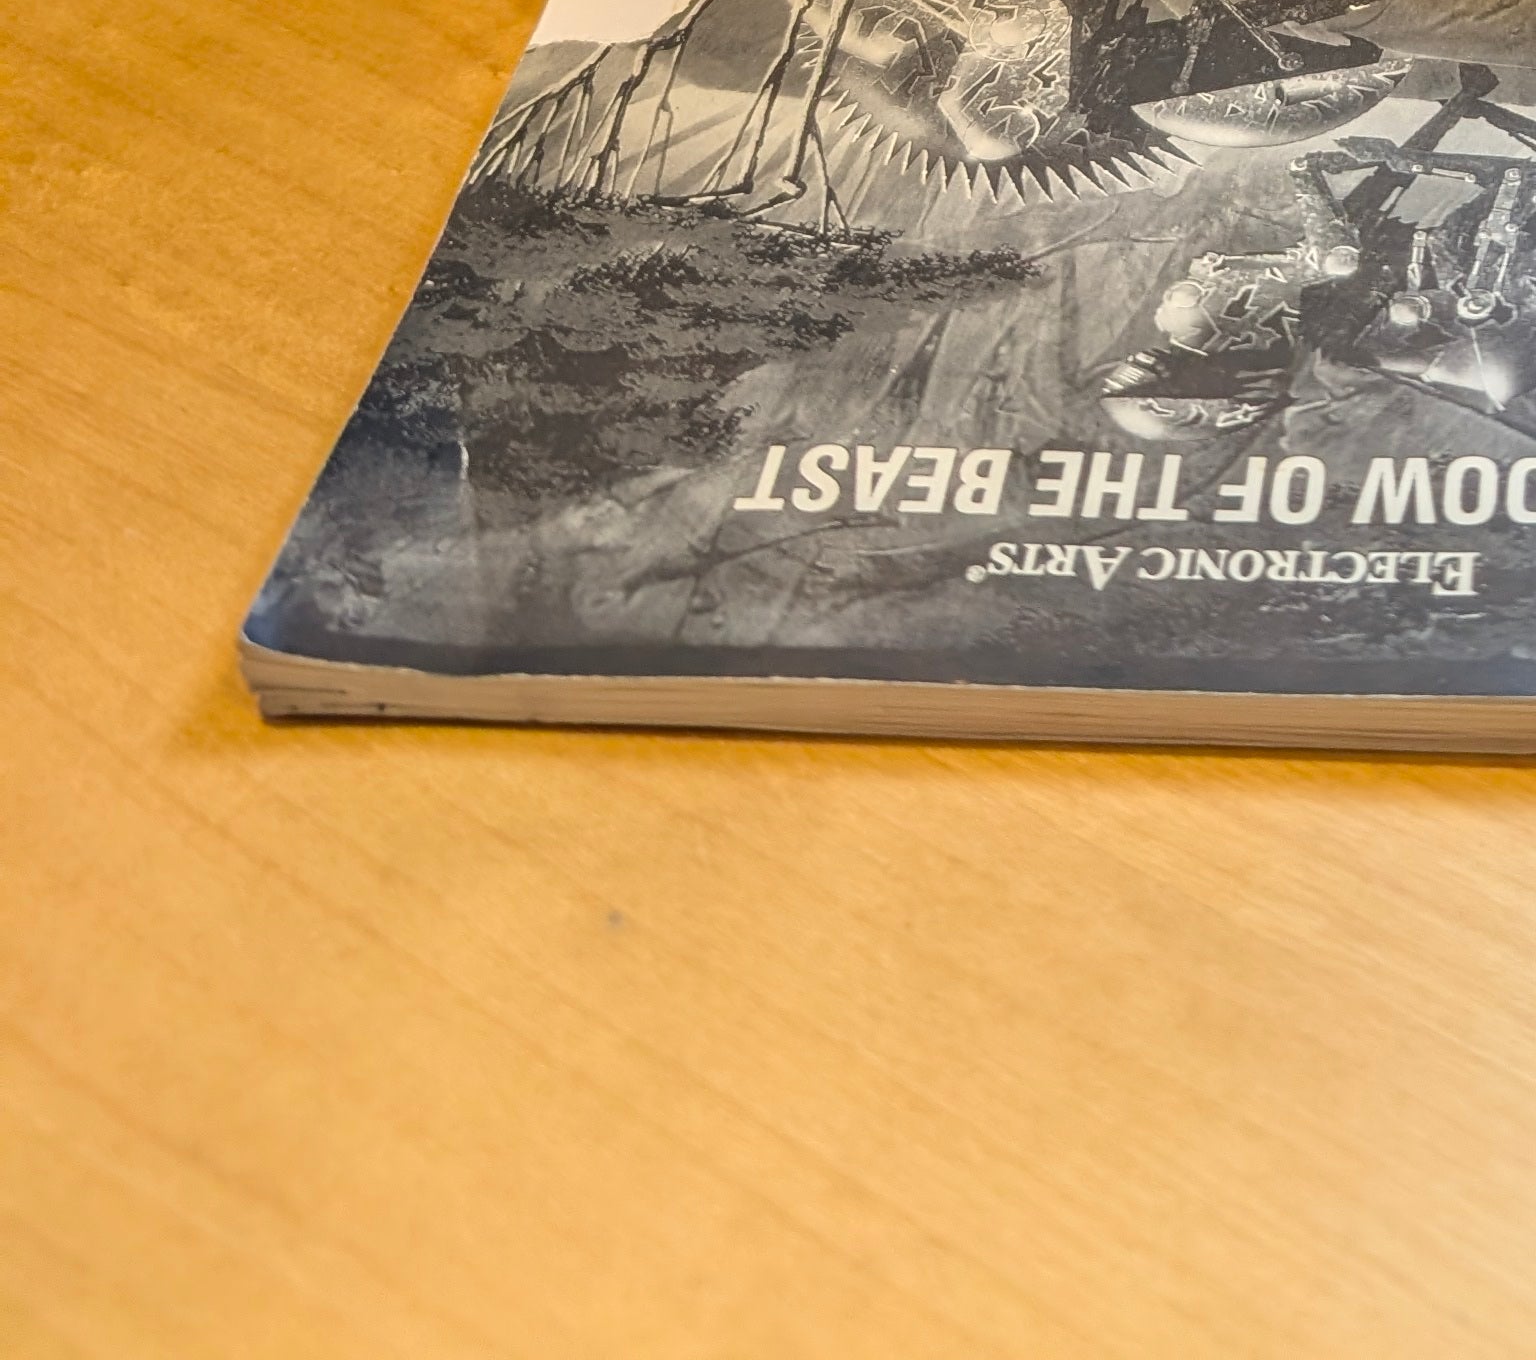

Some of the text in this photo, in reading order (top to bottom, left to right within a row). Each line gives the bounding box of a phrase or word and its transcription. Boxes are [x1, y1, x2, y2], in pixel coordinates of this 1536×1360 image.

[735, 444, 1012, 515] BEAST
[1029, 449, 1192, 521] THE
[1214, 454, 1326, 526] OF
